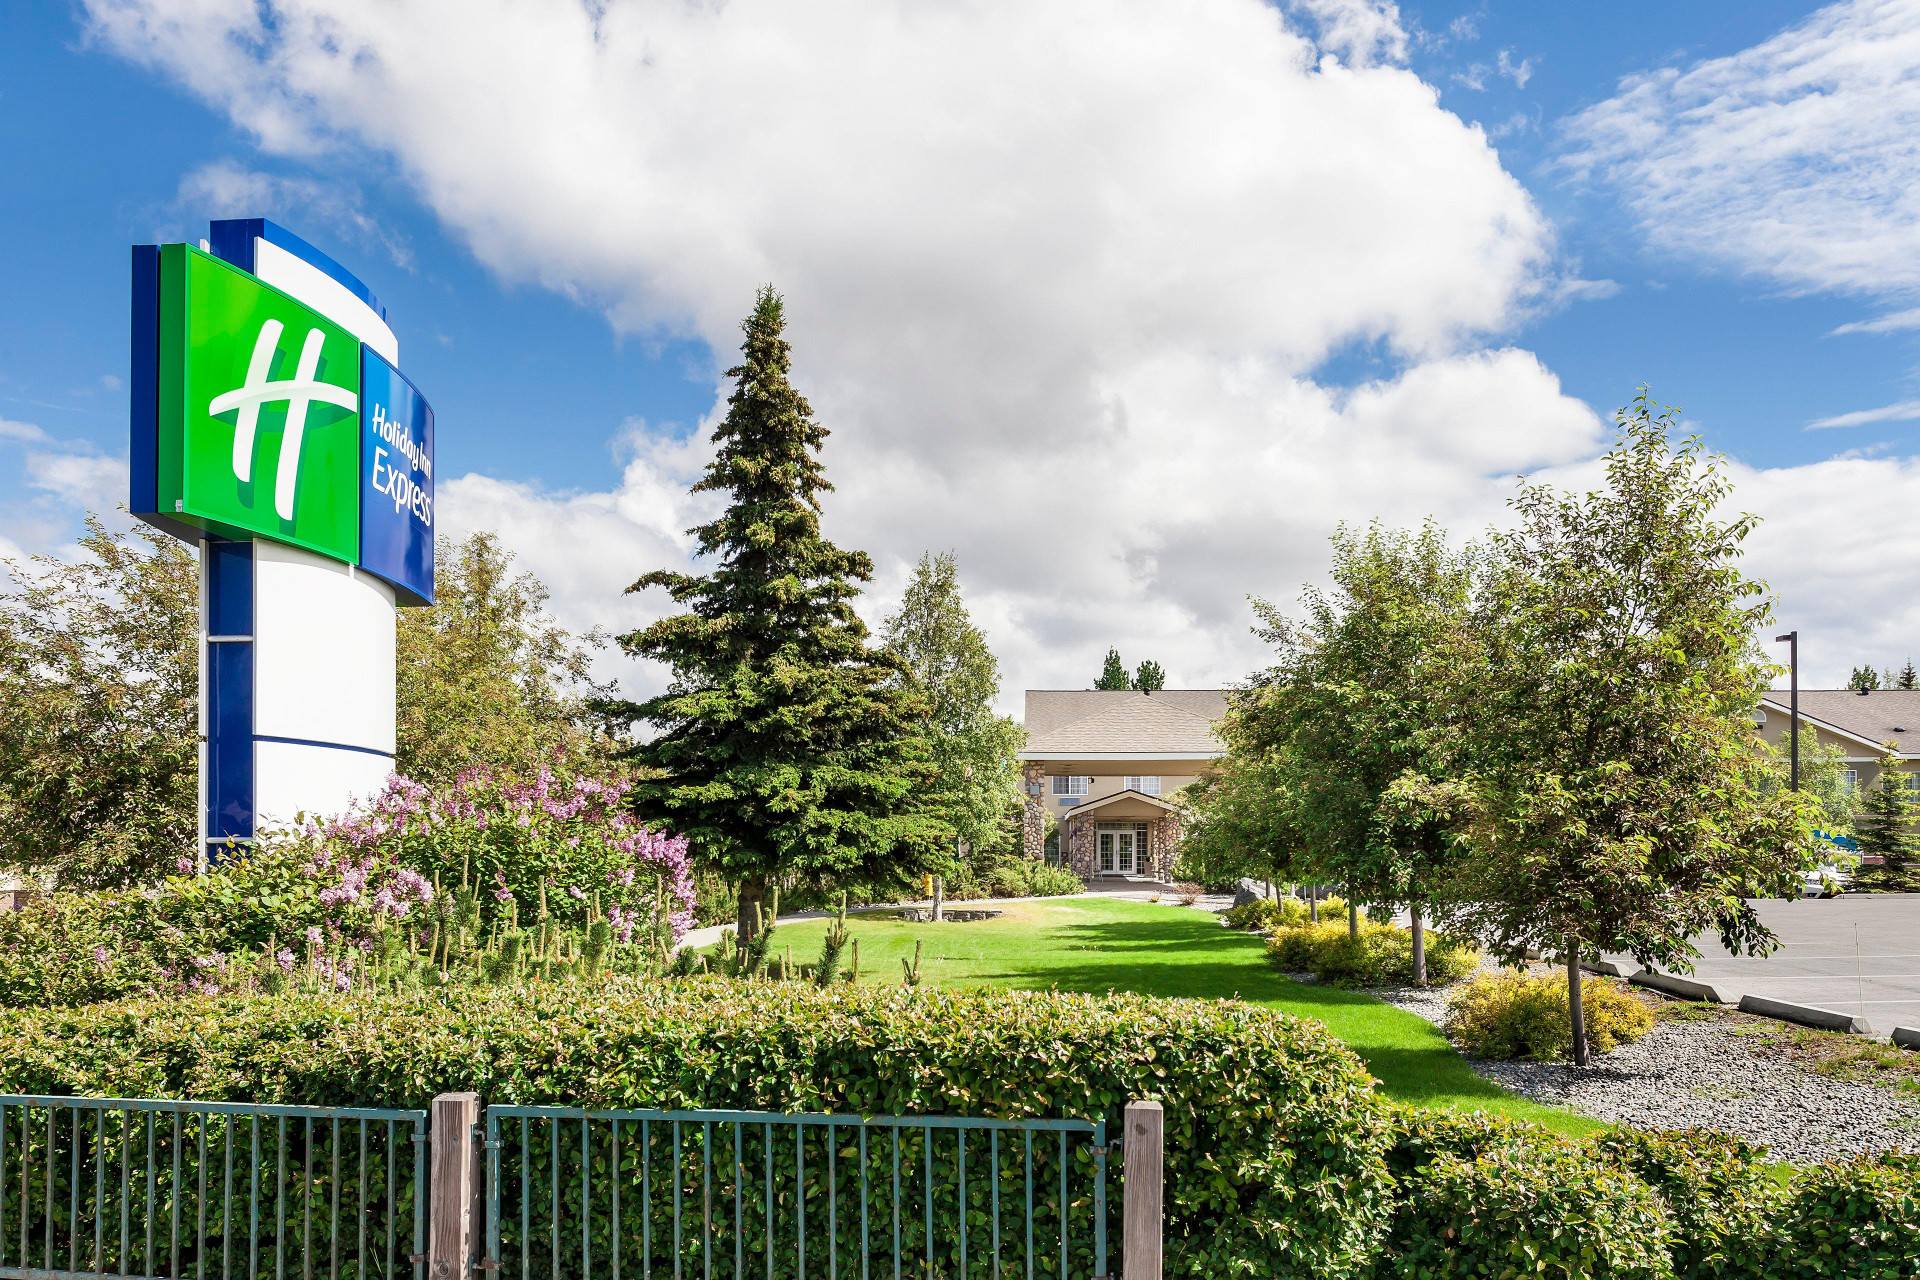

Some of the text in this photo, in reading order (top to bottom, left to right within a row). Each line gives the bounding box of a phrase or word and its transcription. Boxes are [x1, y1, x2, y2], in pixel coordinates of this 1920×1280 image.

[209, 318, 357, 521] H
[372, 403, 431, 480] Holiday Inn
[372, 445, 431, 527] Express
